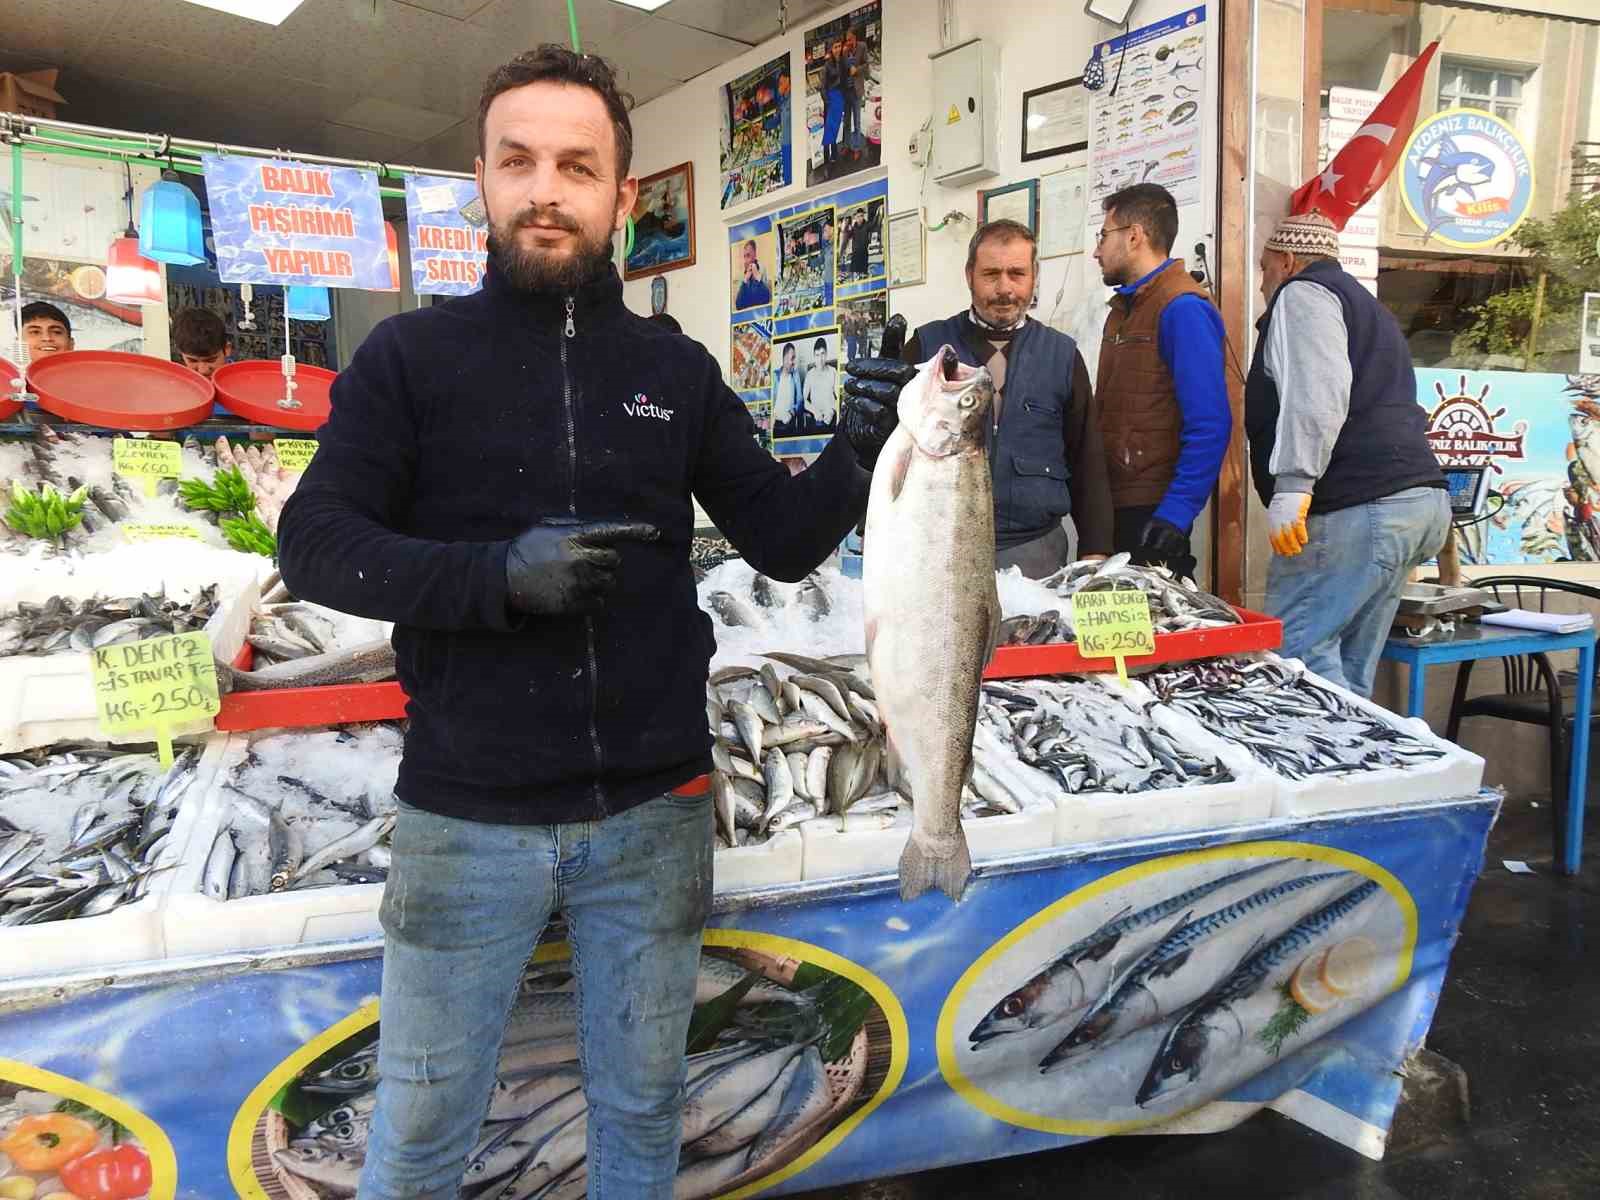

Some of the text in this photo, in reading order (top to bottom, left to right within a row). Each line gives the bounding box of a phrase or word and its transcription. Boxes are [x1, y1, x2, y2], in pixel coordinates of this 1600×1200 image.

[1408, 116, 1529, 177] AKDENİZ BALIKÇILIK
[260, 164, 335, 198] BALIK
[249, 202, 355, 238] PİŞİRİMİ
[418, 226, 473, 252] KREDİ
[263, 248, 353, 277] YAPILIR
[427, 258, 478, 288] SATIŞ
[622, 401, 673, 421] Victus
[1428, 435, 1452, 450] ENİZ
[1075, 593, 1107, 609] KARA
